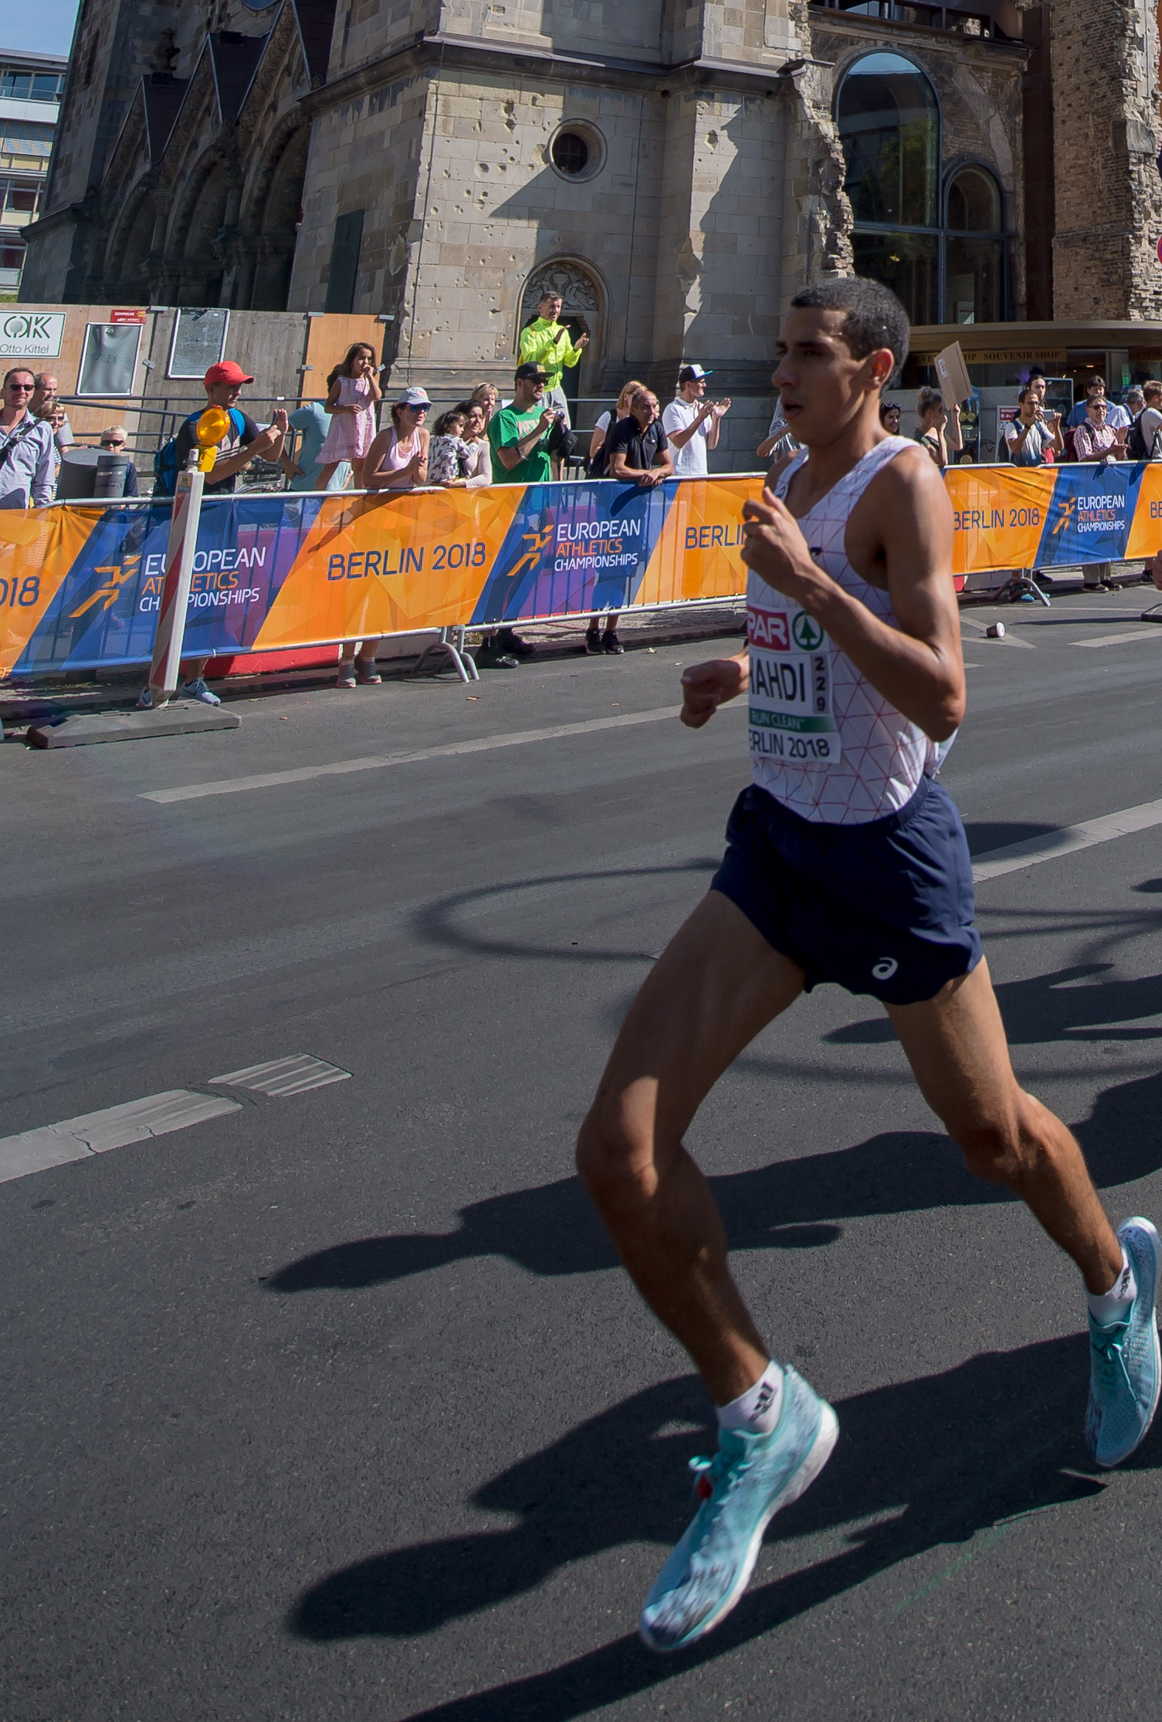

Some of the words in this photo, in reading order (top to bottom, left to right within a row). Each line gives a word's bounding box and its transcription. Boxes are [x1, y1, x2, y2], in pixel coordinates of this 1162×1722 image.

[0, 344, 22, 354] Otto
[24, 344, 49, 354] Kittel
[984, 351, 1032, 361] SOUVENIR
[1034, 351, 1060, 359] SHOP
[1077, 494, 1125, 511] EUROPEAN
[953, 509, 1005, 531] BERLIN
[1009, 507, 1040, 527] 2018
[1077, 509, 1115, 522] ATHLETICS
[1077, 520, 1125, 533] CHAMPIONSHIPS
[557, 519, 641, 541] EUROPEAN
[556, 539, 623, 557] ATHLETICS
[145, 546, 266, 576] EUOPEAN
[327, 547, 424, 581] BERLIN
[432, 542, 486, 570] 2018
[554, 552, 639, 572] CHAMPIONSHIPS
[0, 576, 39, 607] 018
[142, 571, 239, 595] ATETICS
[139, 588, 261, 612] CHPIONSHIPS
[749, 612, 787, 645] PAR
[750, 656, 806, 703] AHDI
[814, 656, 827, 712] 229
[749, 729, 784, 756] RLIN
[788, 736, 830, 759] 2018
